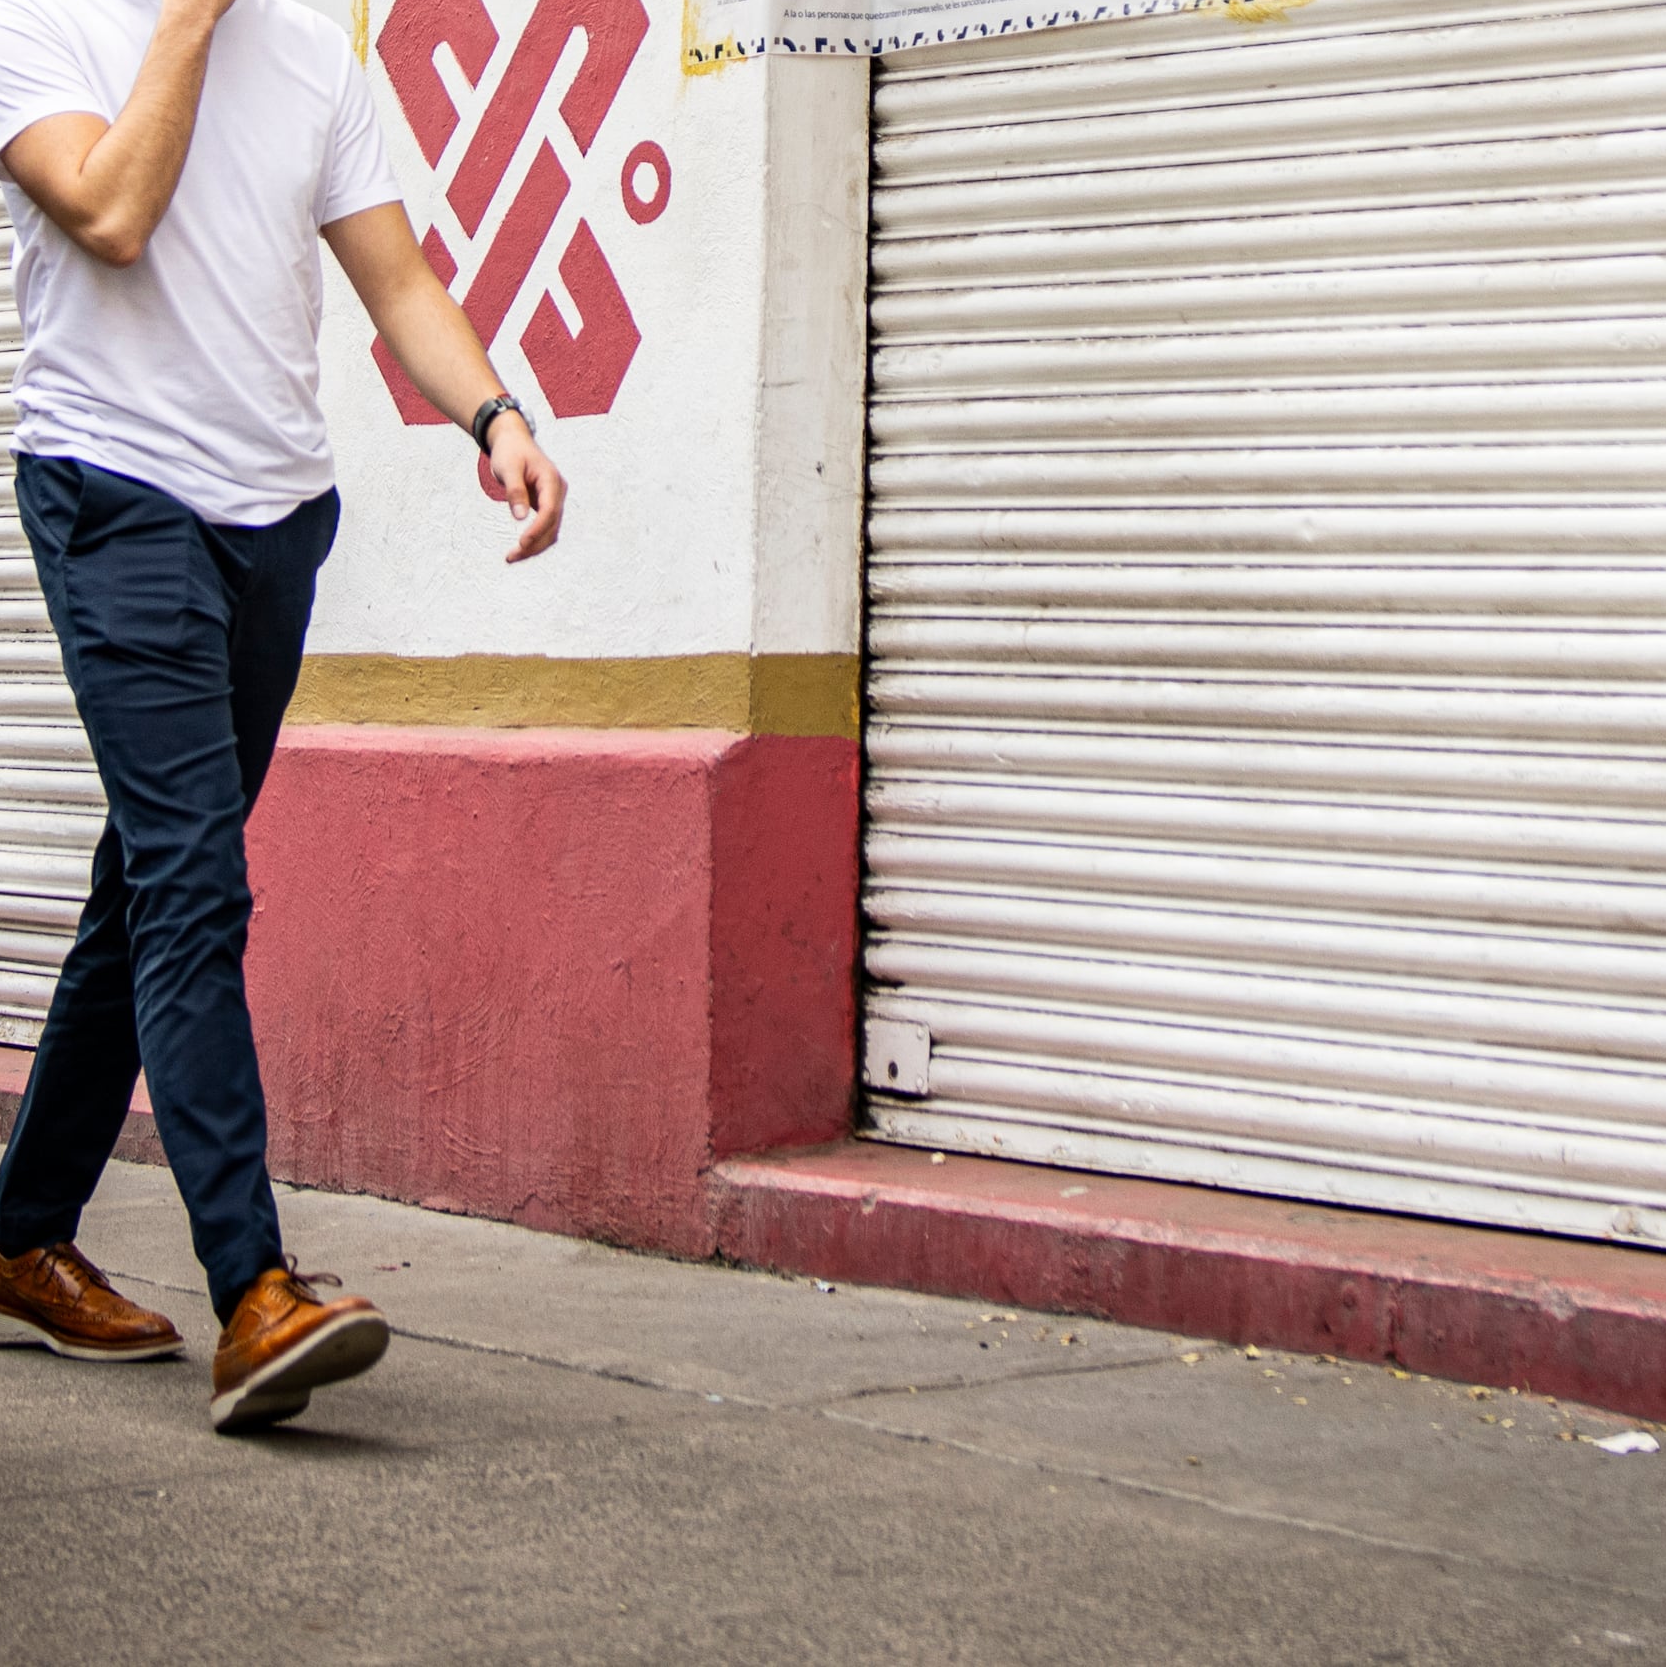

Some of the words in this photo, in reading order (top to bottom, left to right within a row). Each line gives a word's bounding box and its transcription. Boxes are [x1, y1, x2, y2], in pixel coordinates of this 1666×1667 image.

[805, 9, 816, 18] las
[818, 11, 850, 21] personas
[851, 13, 863, 21] que
